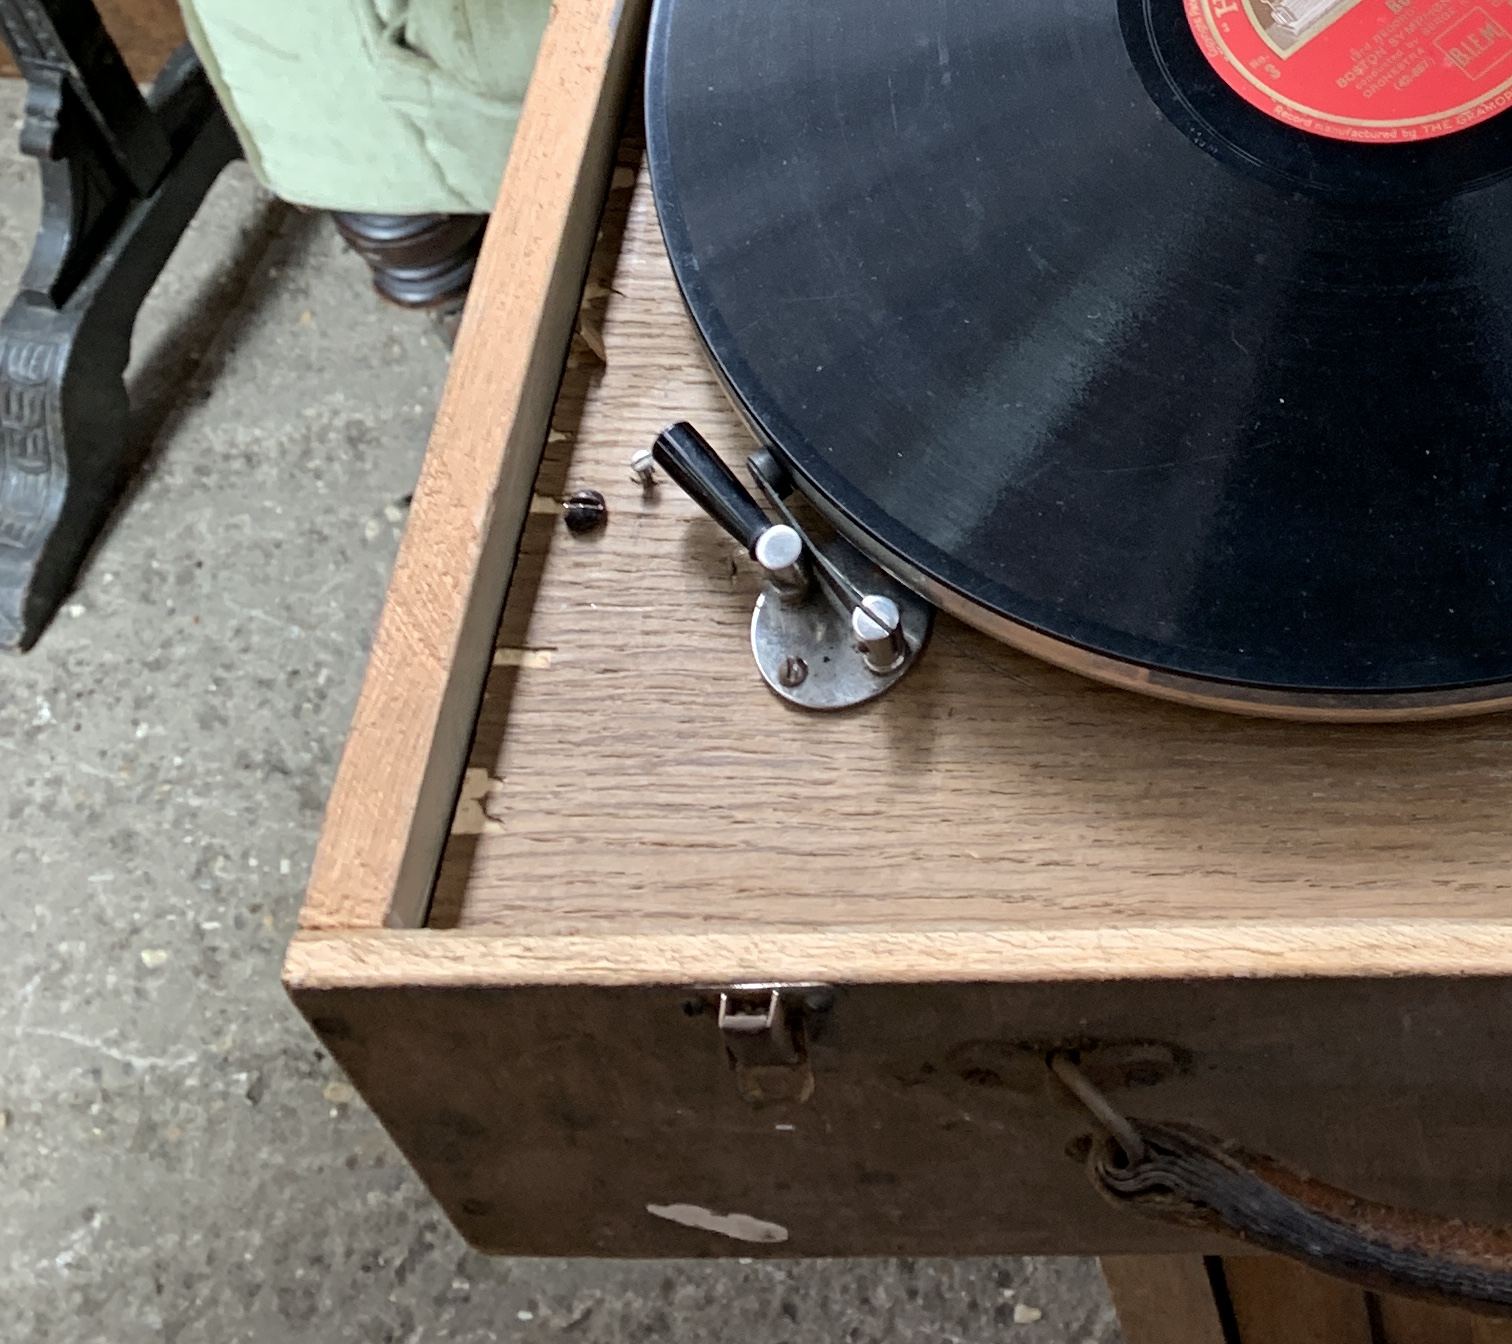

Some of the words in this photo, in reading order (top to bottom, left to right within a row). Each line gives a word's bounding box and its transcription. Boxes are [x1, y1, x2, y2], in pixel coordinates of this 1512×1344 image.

[1334, 45, 1388, 89] BOSTON
[1270, 103, 1314, 128] Record
[1312, 119, 1398, 139] manufactured
[1400, 126, 1417, 140] by
[1421, 117, 1453, 134] THE
